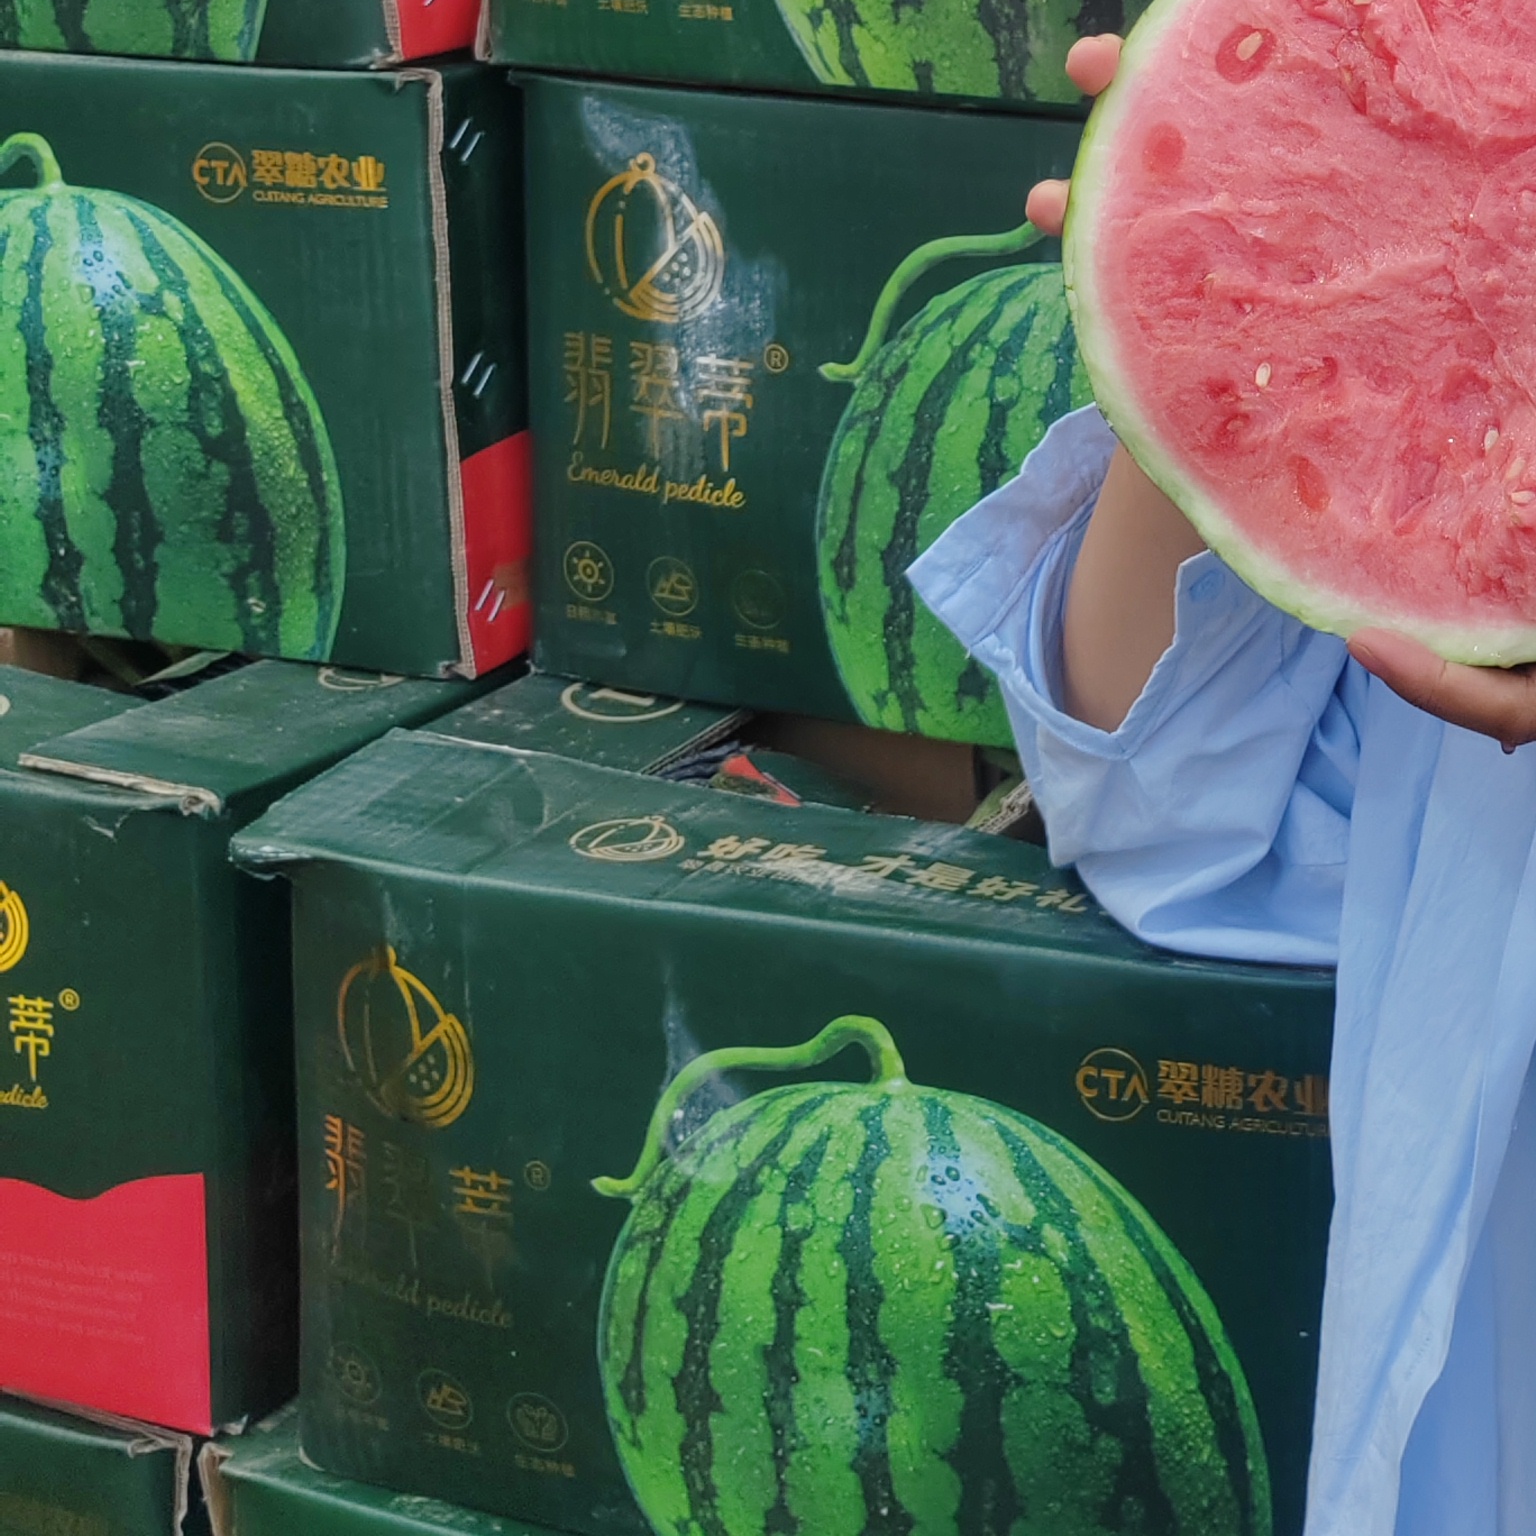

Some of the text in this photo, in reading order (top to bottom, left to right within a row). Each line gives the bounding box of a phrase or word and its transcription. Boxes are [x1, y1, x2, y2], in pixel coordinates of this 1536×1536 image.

[251, 149, 388, 192] 翠糖农业
[252, 190, 389, 209] CUITANG AGRICULTURE
[563, 331, 755, 473] 翡翠蒂
[566, 450, 746, 509] Emerald pedicle
[858, 853, 1089, 913] 才是好礼
[7, 994, 54, 1082] 蒂
[0, 1083, 49, 1110] edicle
[1156, 1059, 1330, 1116] 翠糖农业
[1156, 1109, 1226, 1130] CUITANG
